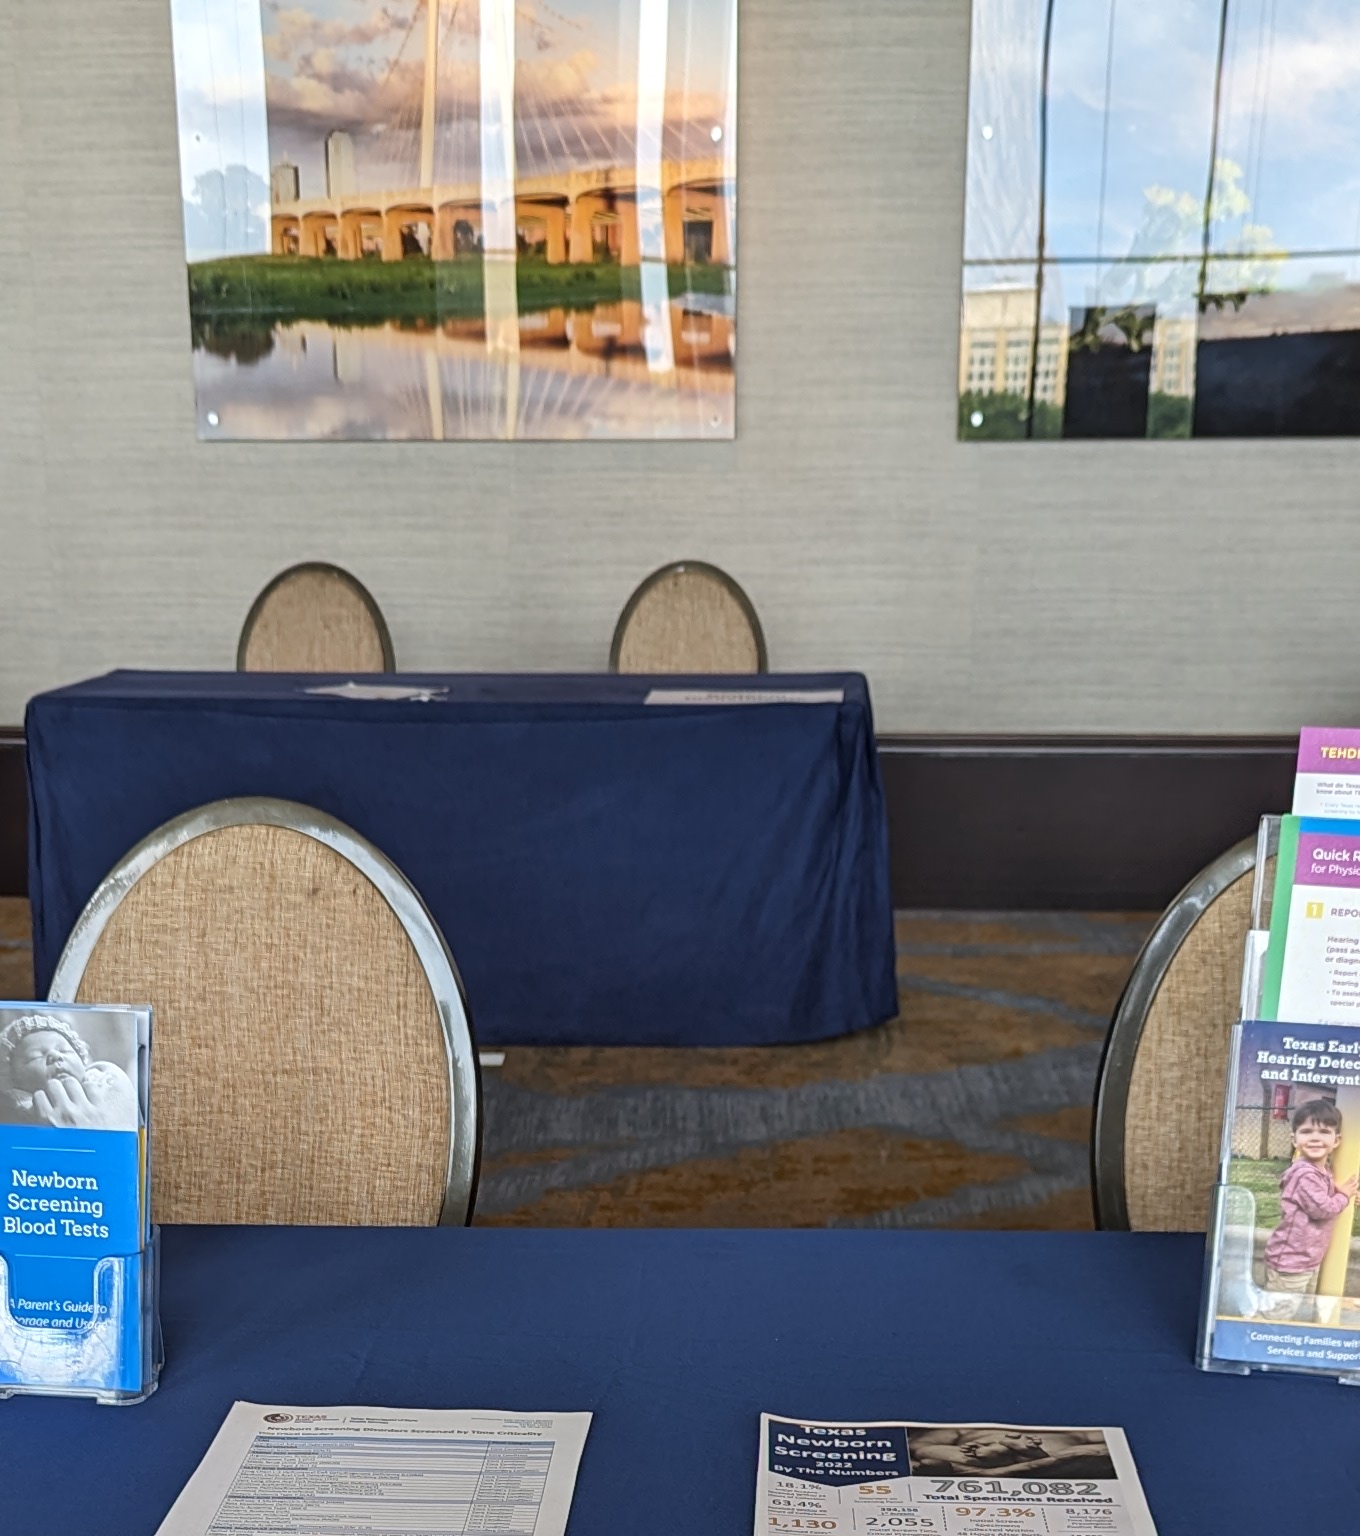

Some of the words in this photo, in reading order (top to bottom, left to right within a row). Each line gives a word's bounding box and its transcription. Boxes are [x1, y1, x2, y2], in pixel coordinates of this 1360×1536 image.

[1321, 746, 1360, 759] TEHDI
[1313, 848, 1350, 862] Quick
[1311, 863, 1326, 874] for
[1311, 903, 1317, 916] 1
[1327, 936, 1359, 946] Hearing
[1283, 1037, 1325, 1052] Texas
[1257, 1051, 1316, 1071] Hearing
[1261, 1069, 1288, 1080] and
[12, 1169, 98, 1191] Newborn
[7, 1193, 103, 1218] Screening
[3, 1216, 56, 1236] Blood
[60, 1218, 109, 1239] Tests
[63, 1301, 93, 1313] Guide
[1250, 1331, 1302, 1348] Connecting
[1304, 1335, 1341, 1347] Families
[1267, 1345, 1305, 1358] Services
[1307, 1348, 1324, 1358] and
[800, 1425, 866, 1436] Texas
[778, 1434, 891, 1447] Newborn
[775, 1446, 897, 1461] Screening
[796, 1467, 824, 1475] The
[777, 1481, 822, 1490] 18.1%
[859, 1486, 891, 1495] 55
[930, 1480, 1101, 1496] 761,082
[772, 1499, 822, 1508] 63.4%
[955, 1507, 1035, 1517] 97.3%
[768, 1517, 837, 1530] 1,130
[865, 1518, 934, 1527] 2,055
